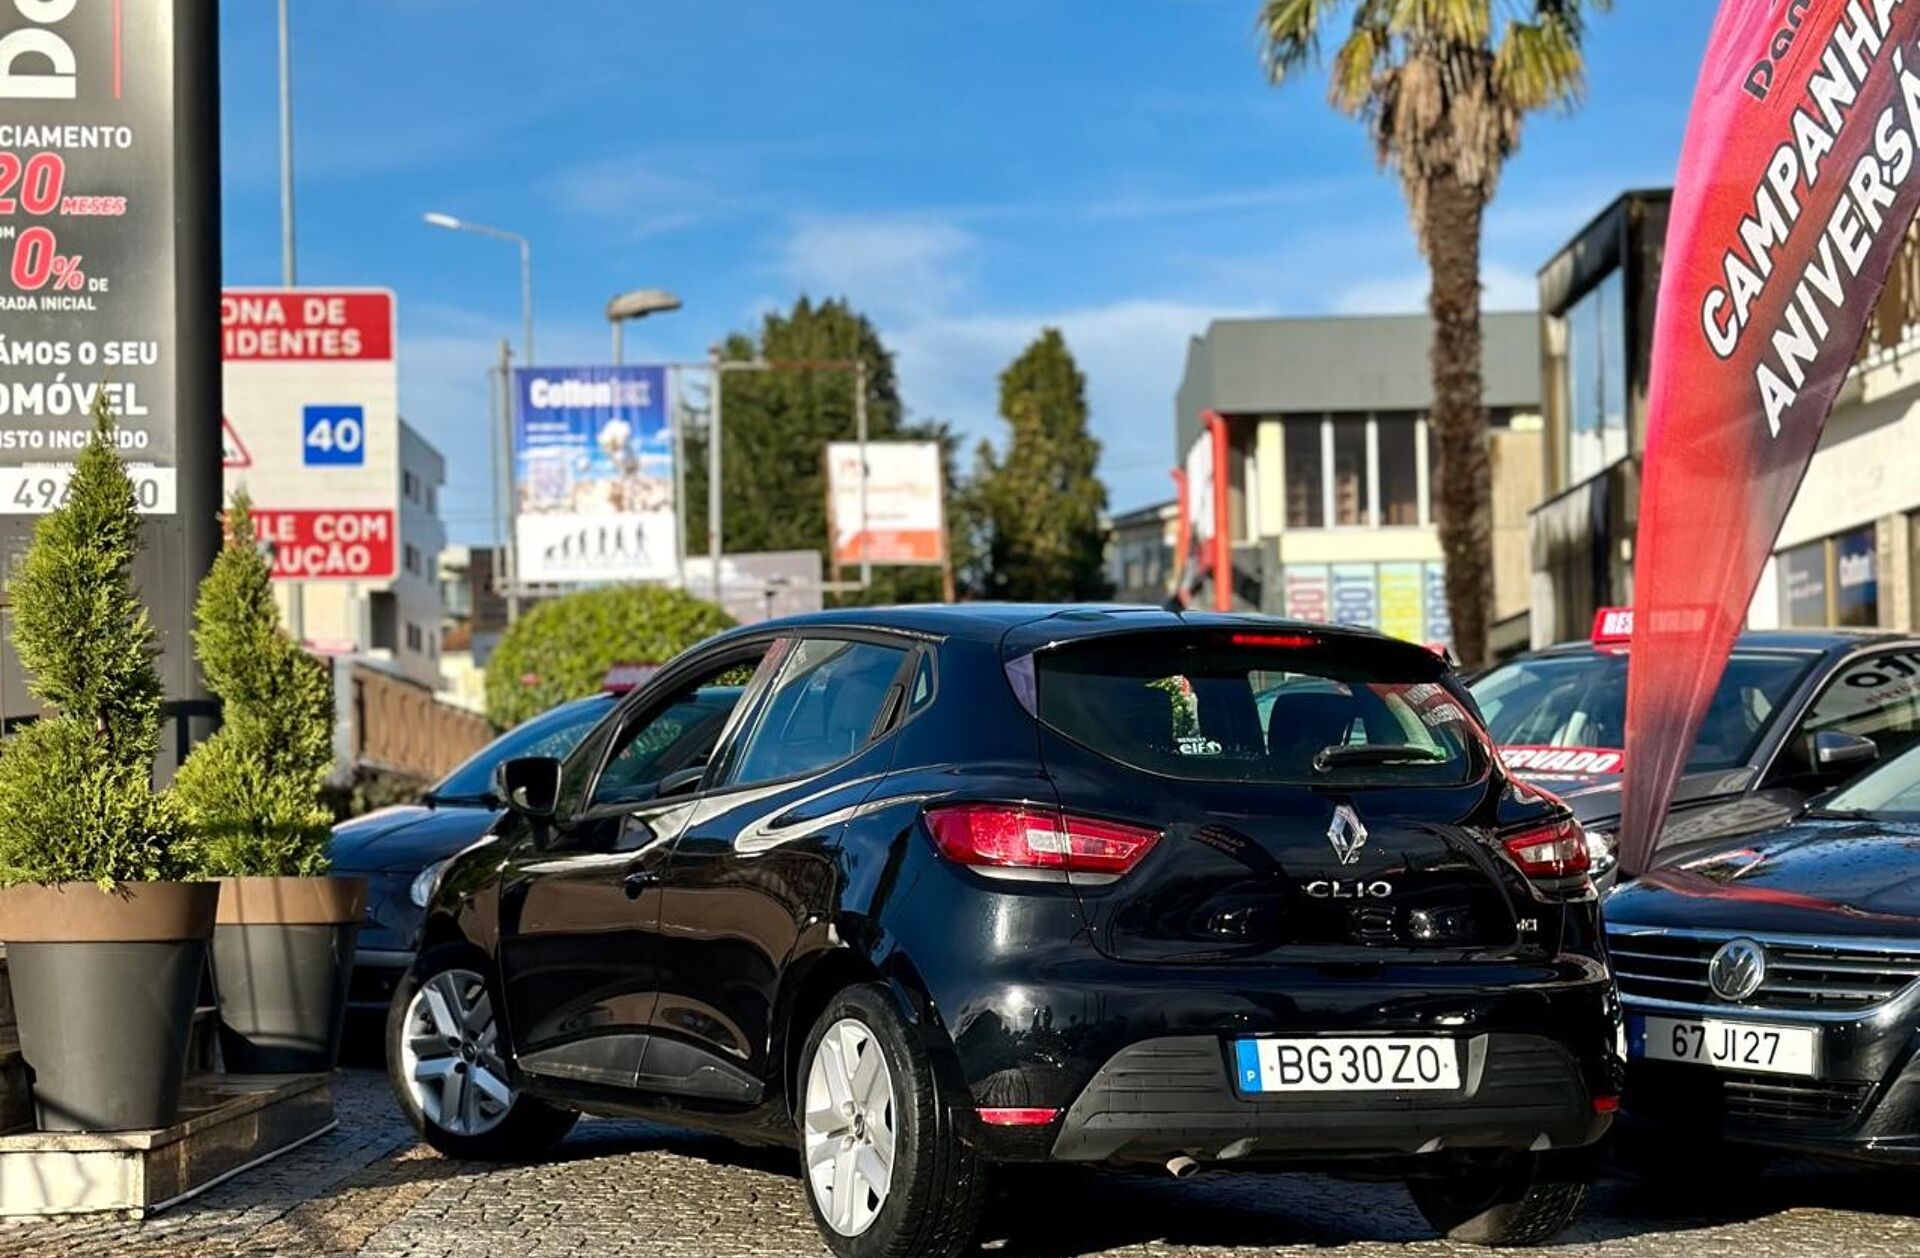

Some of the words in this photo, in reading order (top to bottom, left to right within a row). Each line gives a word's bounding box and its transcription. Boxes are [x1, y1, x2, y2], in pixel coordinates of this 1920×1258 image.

[0, 125, 132, 148] CIAMENTO
[61, 196, 127, 215] MESES
[11, 226, 85, 290] 0%
[88, 278, 109, 292] DE
[41, 297, 96, 311] INICIAL
[303, 298, 346, 325] DE
[78, 341, 97, 365] O
[103, 341, 157, 365] SEU
[224, 329, 362, 356] IDENTES
[307, 419, 361, 451] 40
[313, 514, 386, 541] COM
[1307, 880, 1392, 898] CLIO
[1246, 1070, 1256, 1082] P
